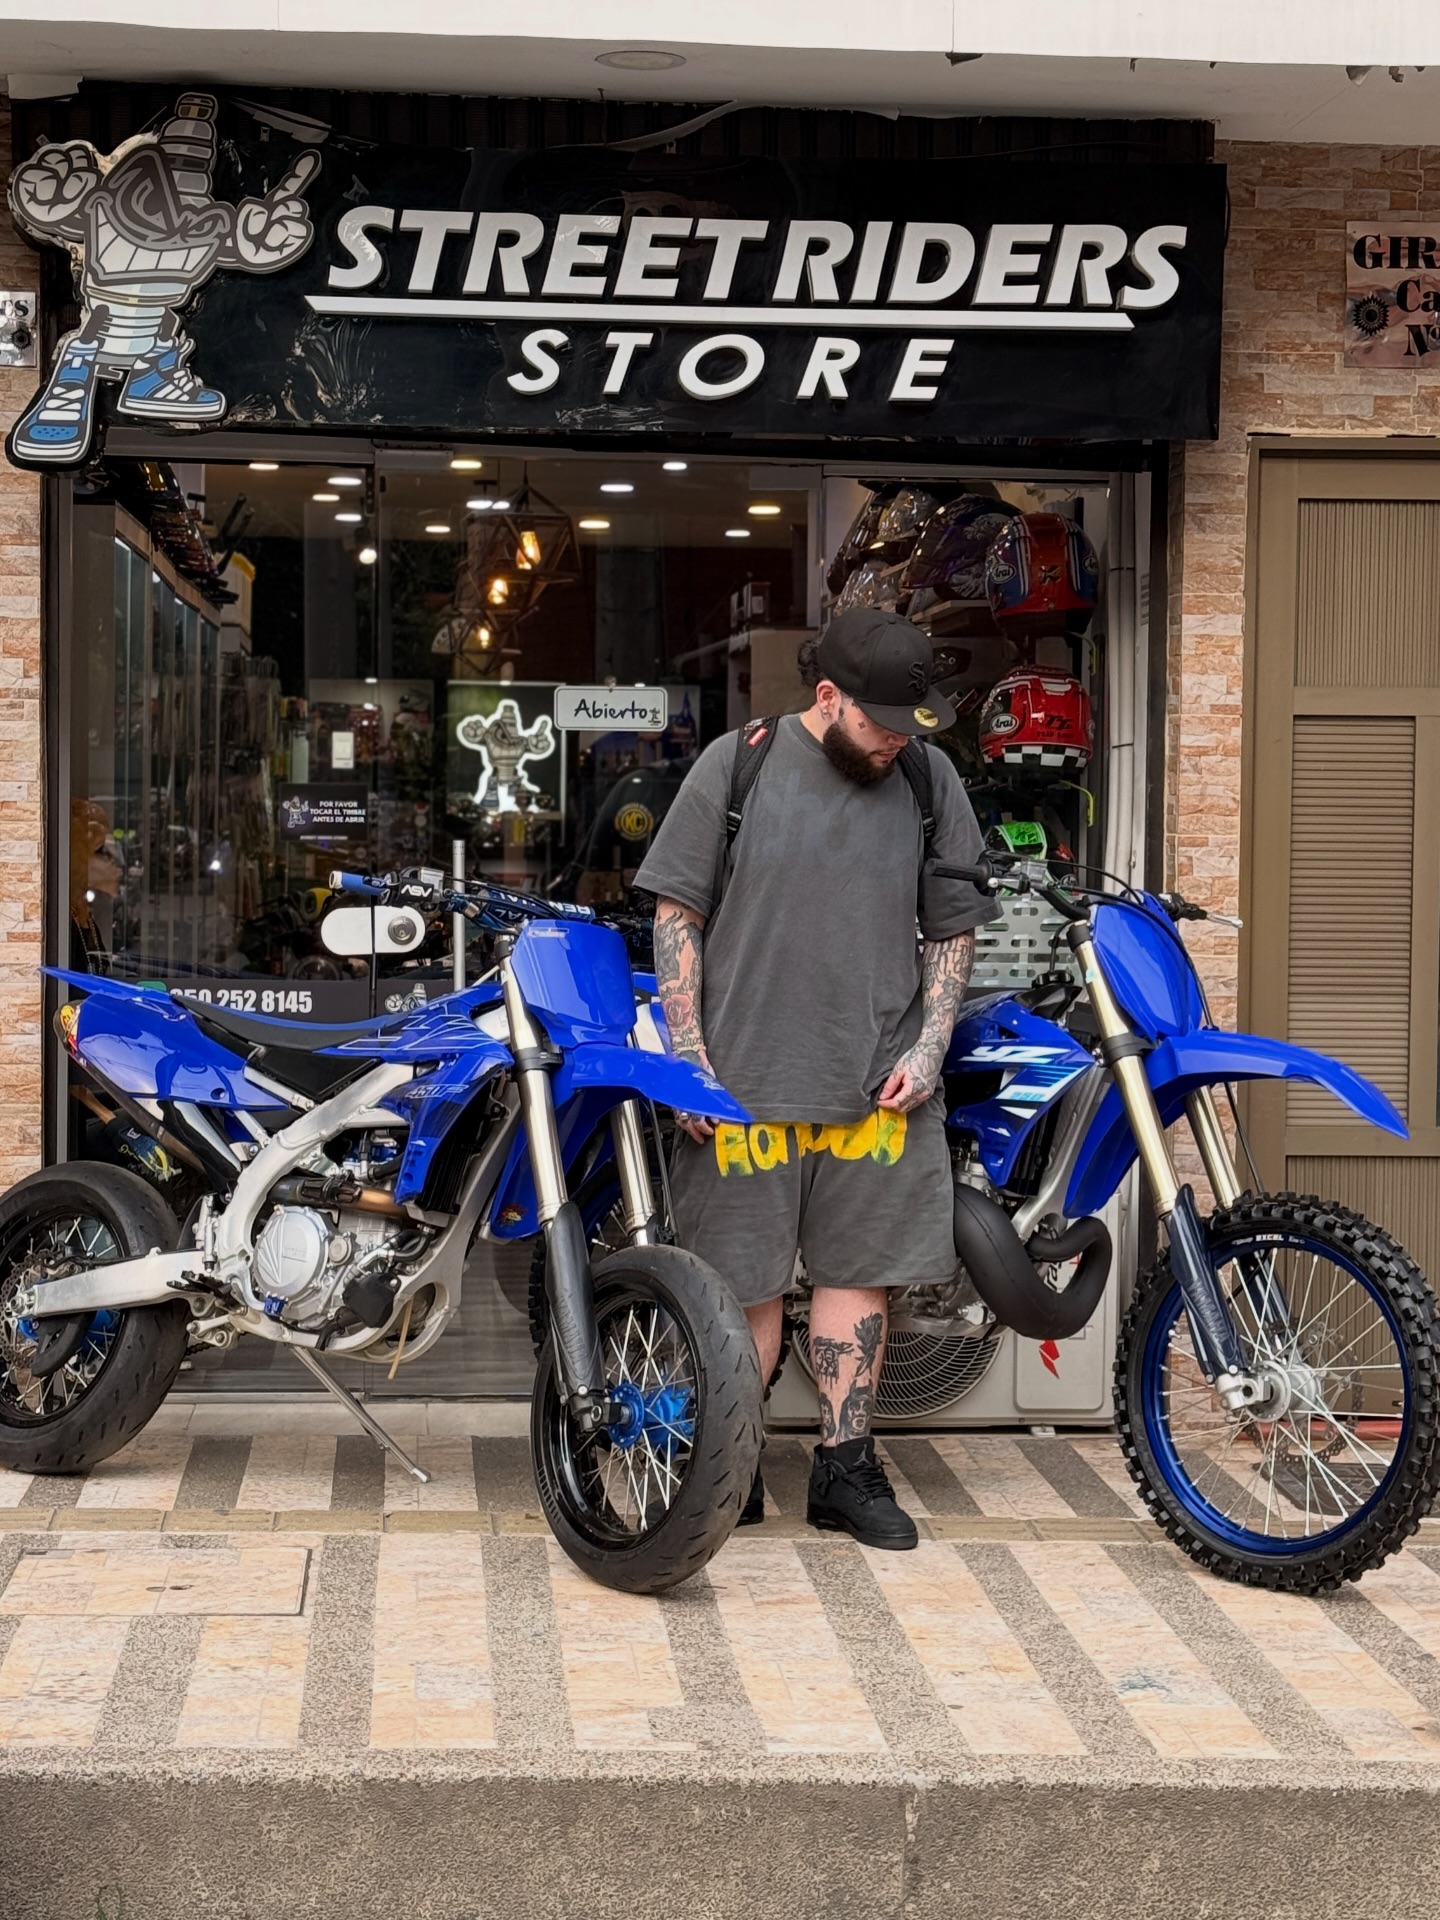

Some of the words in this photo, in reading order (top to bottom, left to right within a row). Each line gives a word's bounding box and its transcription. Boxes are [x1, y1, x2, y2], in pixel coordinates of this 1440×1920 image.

[328, 205, 769, 301] STREET
[771, 219, 1188, 310] RIDERS
[507, 328, 955, 401] STORE
[574, 698, 648, 719] Abierto
[994, 718, 1014, 729] Arai
[319, 800, 334, 808] POR
[335, 800, 358, 808] FAVOR
[401, 884, 433, 898] ASV
[217, 989, 257, 1012] 252
[261, 990, 313, 1014] 8145
[1255, 1233, 1285, 1242] EXCEL
